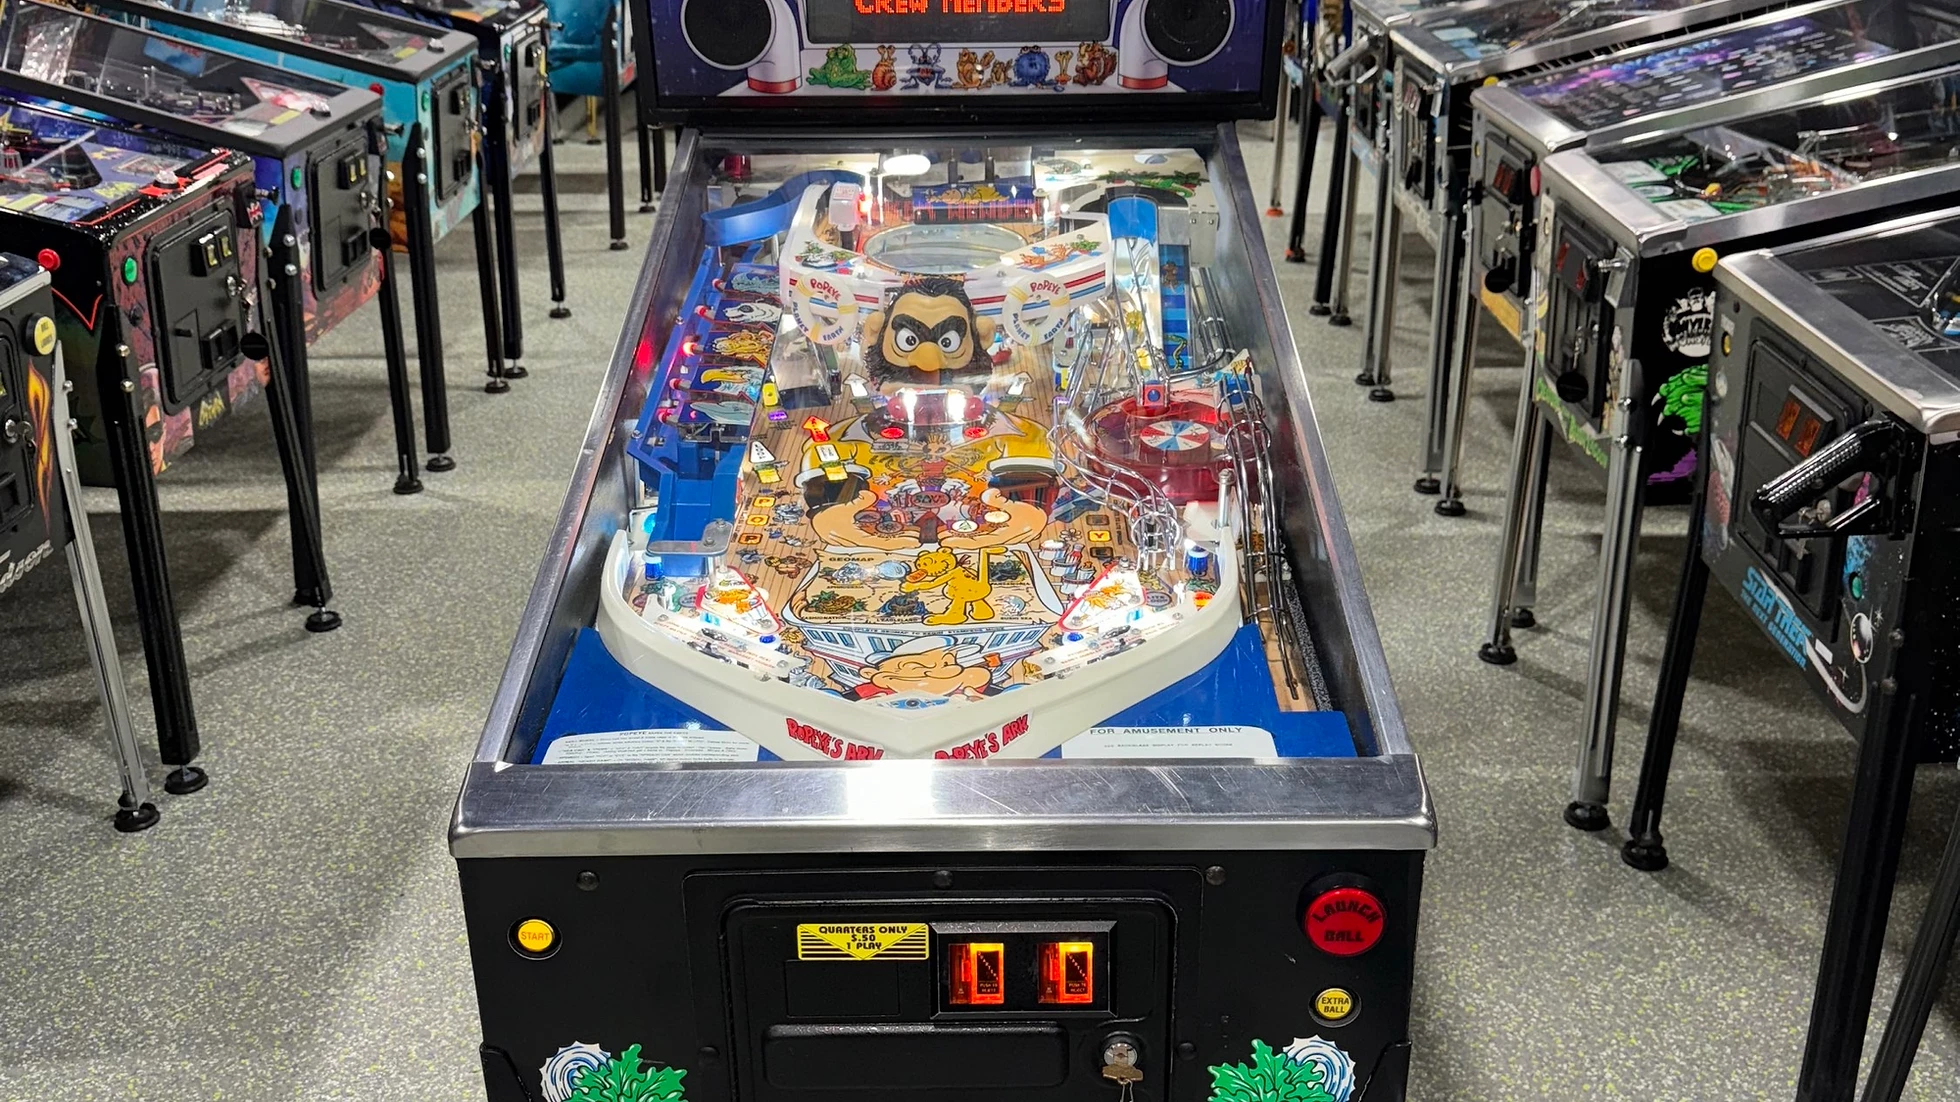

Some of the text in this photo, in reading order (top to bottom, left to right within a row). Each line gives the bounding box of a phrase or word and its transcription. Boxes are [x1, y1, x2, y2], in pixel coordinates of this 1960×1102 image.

[854, 0, 1065, 14] CREW MEMBERS
[809, 277, 842, 301] POPEYE
[1030, 279, 1061, 296] POPEYE
[793, 301, 844, 341] PLANET EARTH
[1012, 312, 1065, 340] PLANET EARTH
[1742, 566, 1813, 656] STAR TREK
[1001, 713, 1030, 747] ARK
[1208, 726, 1243, 734] ONLY
[785, 717, 844, 760] POPEYE'S
[1311, 901, 1381, 923] LAUNCH
[521, 931, 550, 941] START
[818, 926, 908, 934] QUARTERS ONLY
[1324, 930, 1364, 942] BALL
[851, 934, 876, 942] $.50
[846, 942, 882, 950] 1 PLAY
[1321, 997, 1350, 1005] EXTRA
